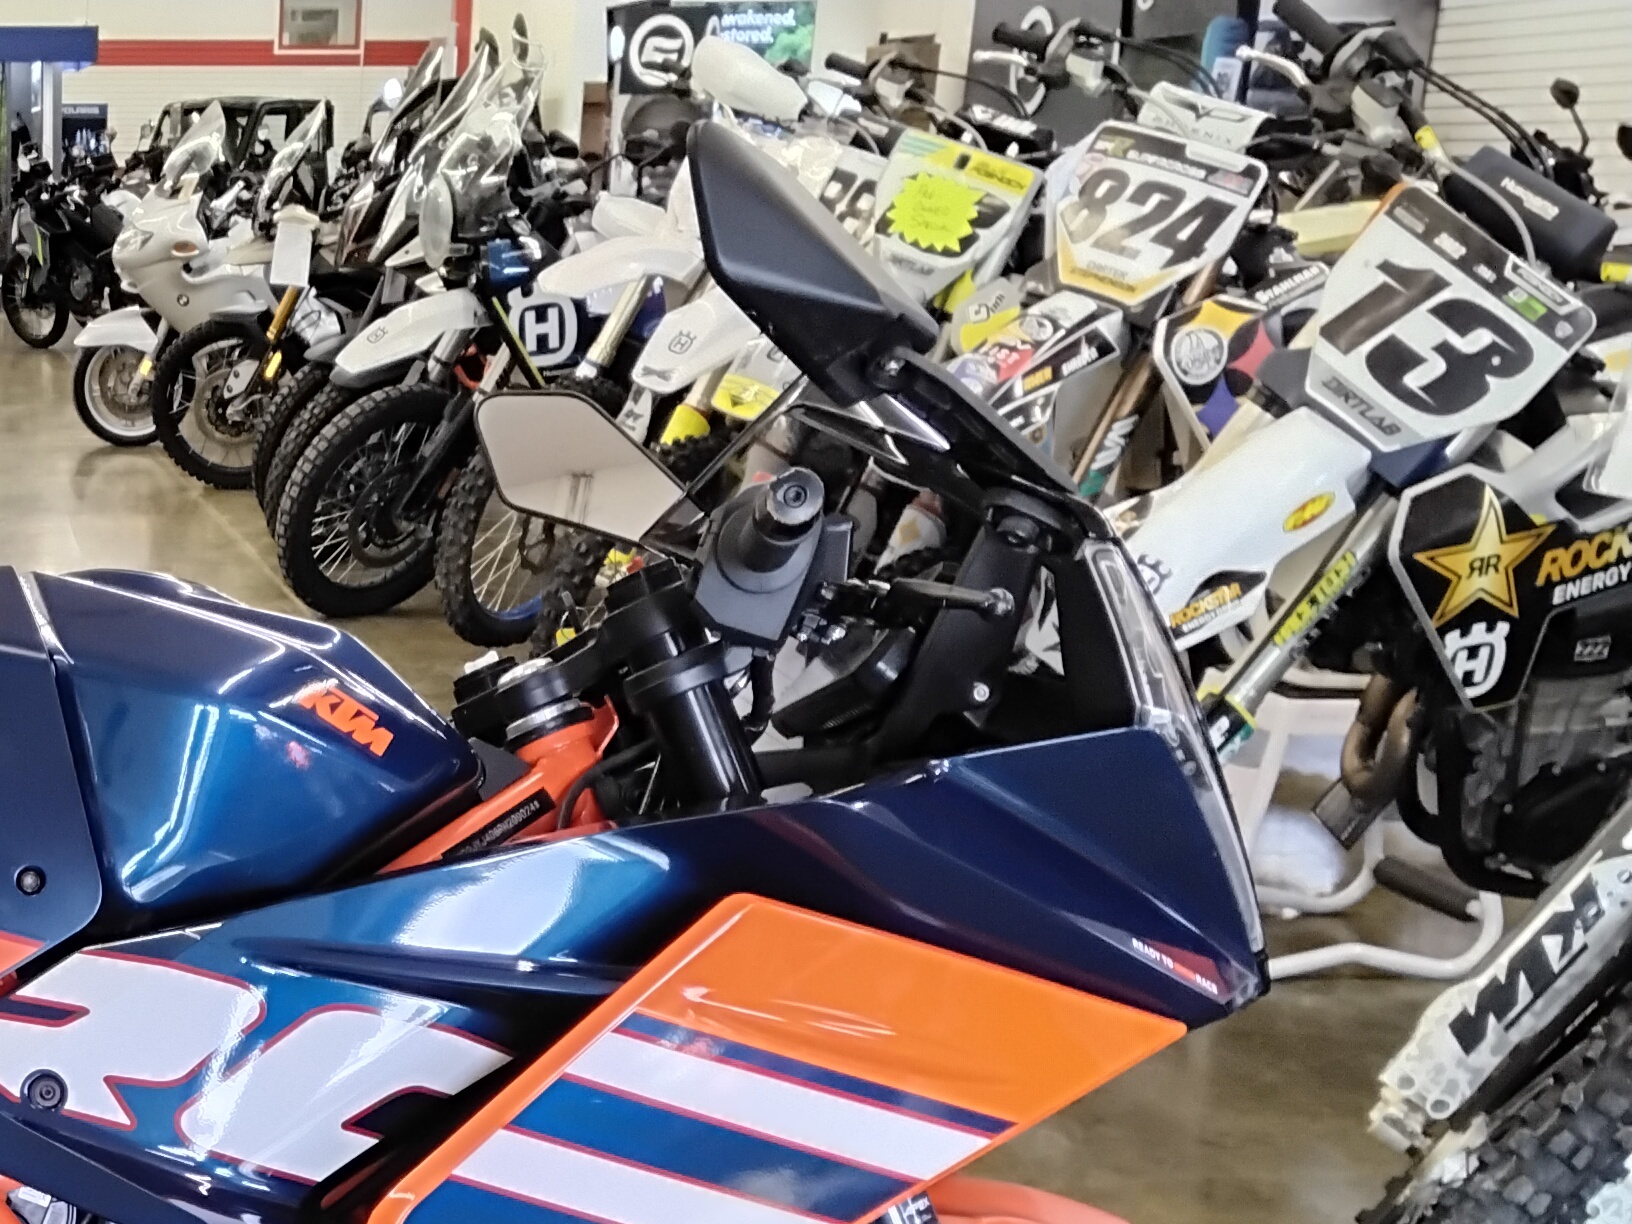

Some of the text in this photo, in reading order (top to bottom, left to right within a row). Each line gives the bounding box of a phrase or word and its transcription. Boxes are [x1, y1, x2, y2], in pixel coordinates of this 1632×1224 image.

[1060, 167, 1238, 270] 824
[1319, 258, 1535, 417] 13
[1321, 375, 1402, 437] DIRTLAB
[1552, 561, 1632, 606] ENERGY
[294, 678, 395, 757] KTM
[1131, 936, 1218, 995] READY TO RACE
